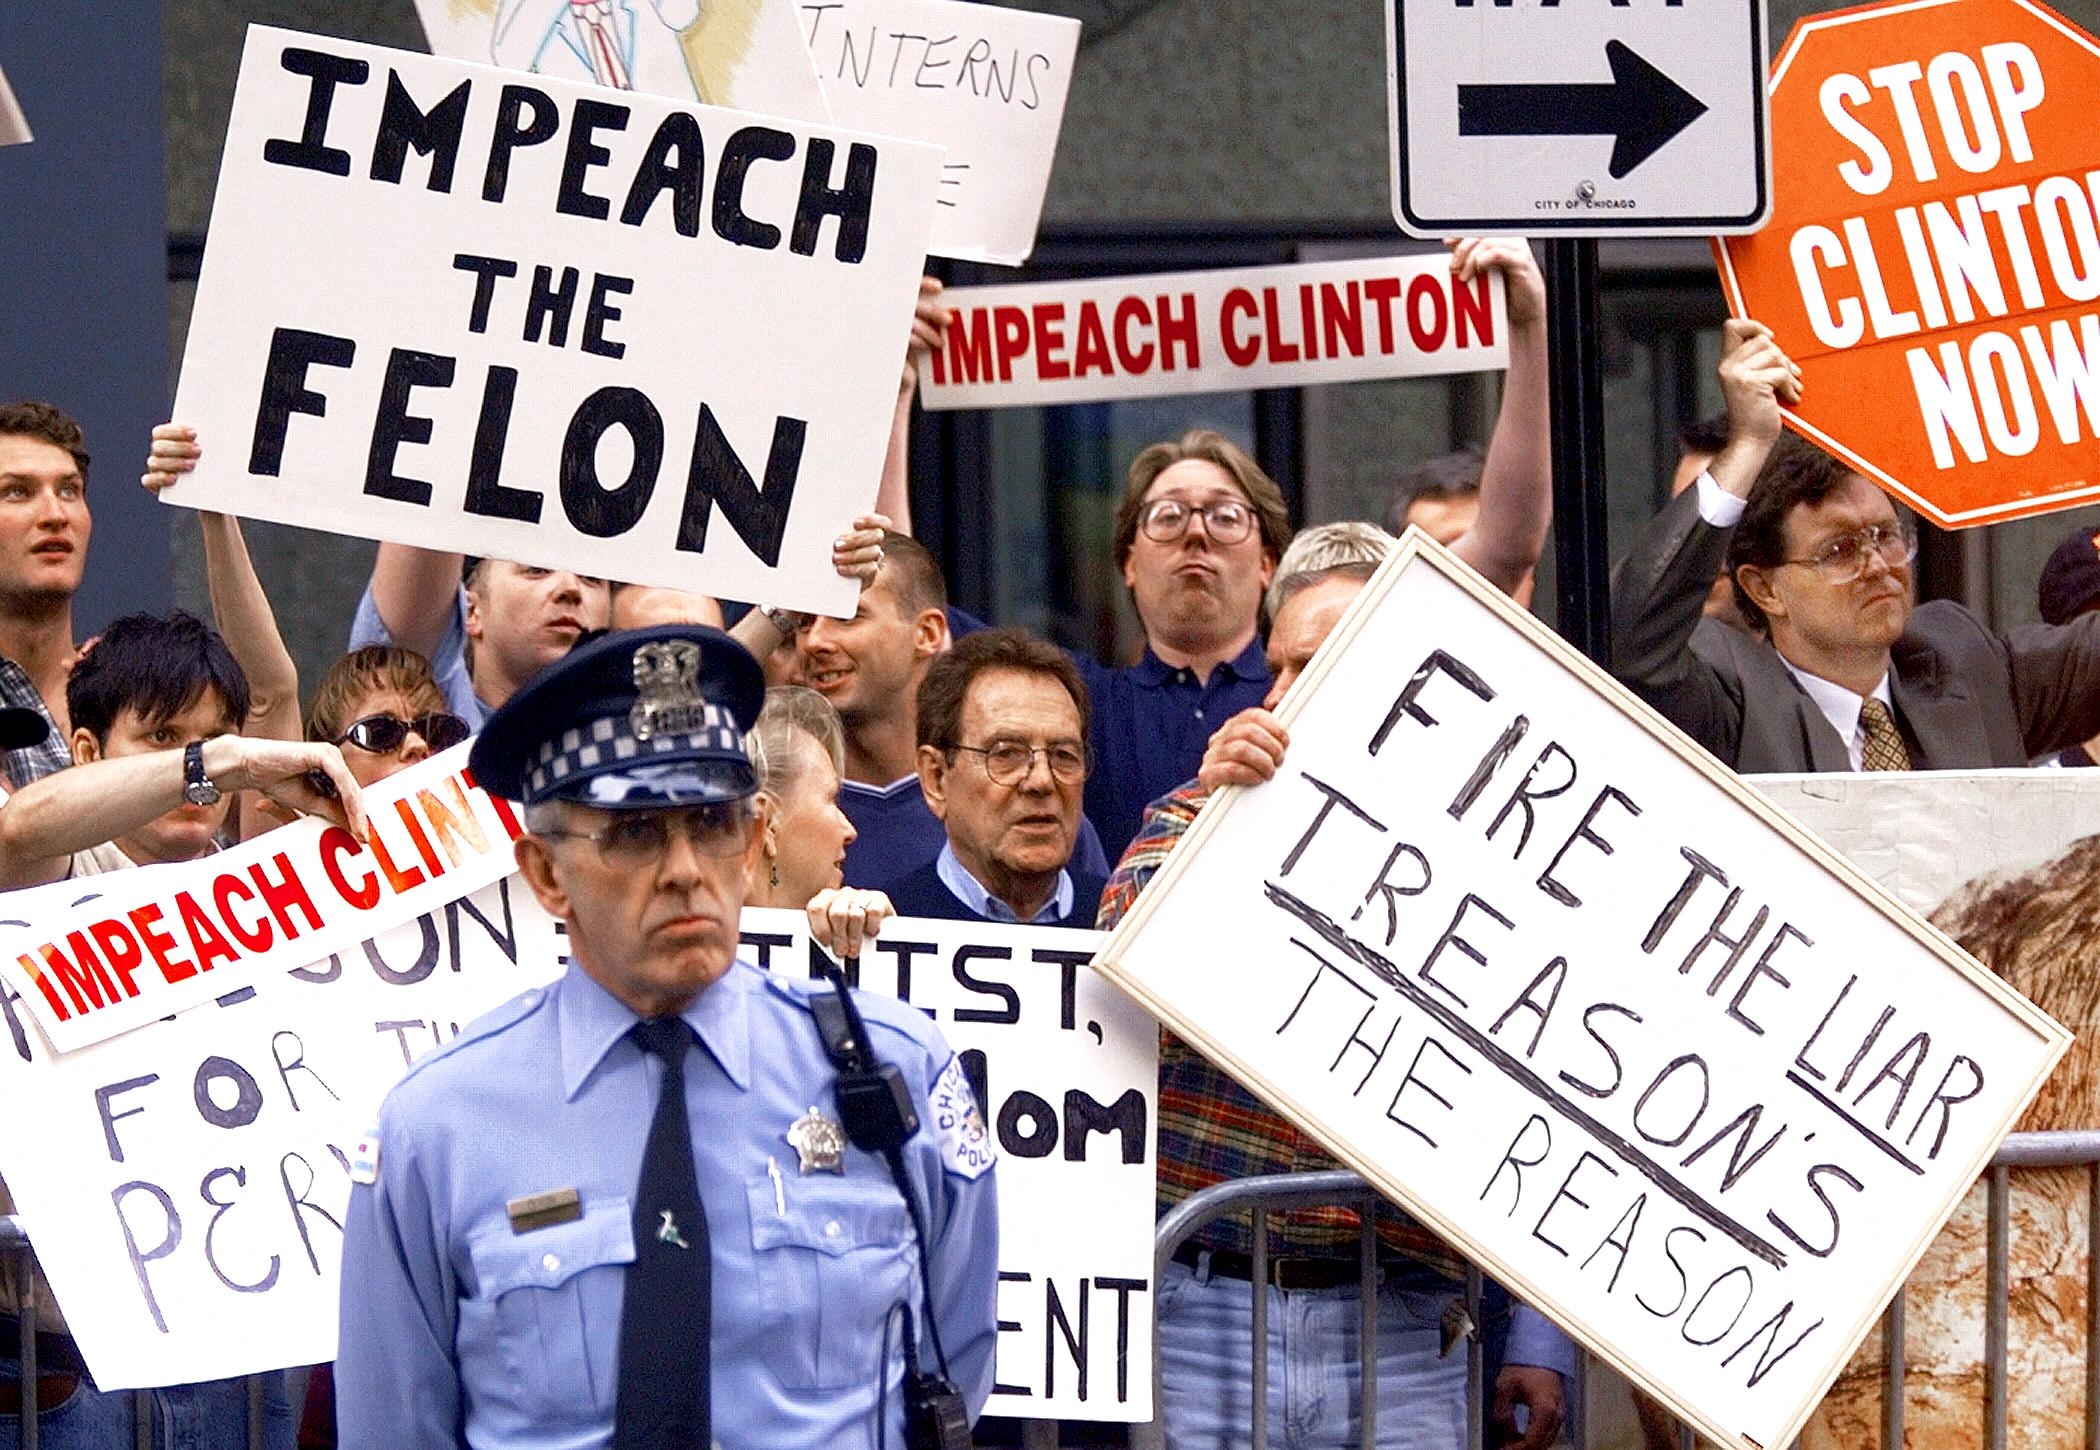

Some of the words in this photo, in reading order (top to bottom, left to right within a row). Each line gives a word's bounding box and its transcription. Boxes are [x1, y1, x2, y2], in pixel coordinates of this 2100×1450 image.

[263, 47, 877, 264] IMPEACH
[1534, 199, 1561, 210] CITY
[1565, 199, 1580, 210] OF
[1585, 199, 1637, 210] CHICAGO
[1819, 42, 2045, 195] STOP
[453, 254, 634, 359] THE
[1220, 271, 1494, 368] CLINTON
[1790, 170, 2100, 348] CLINTO
[248, 326, 805, 568] FELON
[1906, 314, 2100, 469] NOW
[17, 852, 325, 1022] IMPEACH
[1367, 648, 1642, 908] FIRE
[1641, 846, 1815, 1036] THE
[1791, 974, 1985, 1160] LIAR
[94, 1031, 341, 1162] FOR
[1276, 936, 1473, 1149] THE
[1281, 771, 1864, 1257] TREASON'S
[1480, 1114, 1823, 1389] REASON
